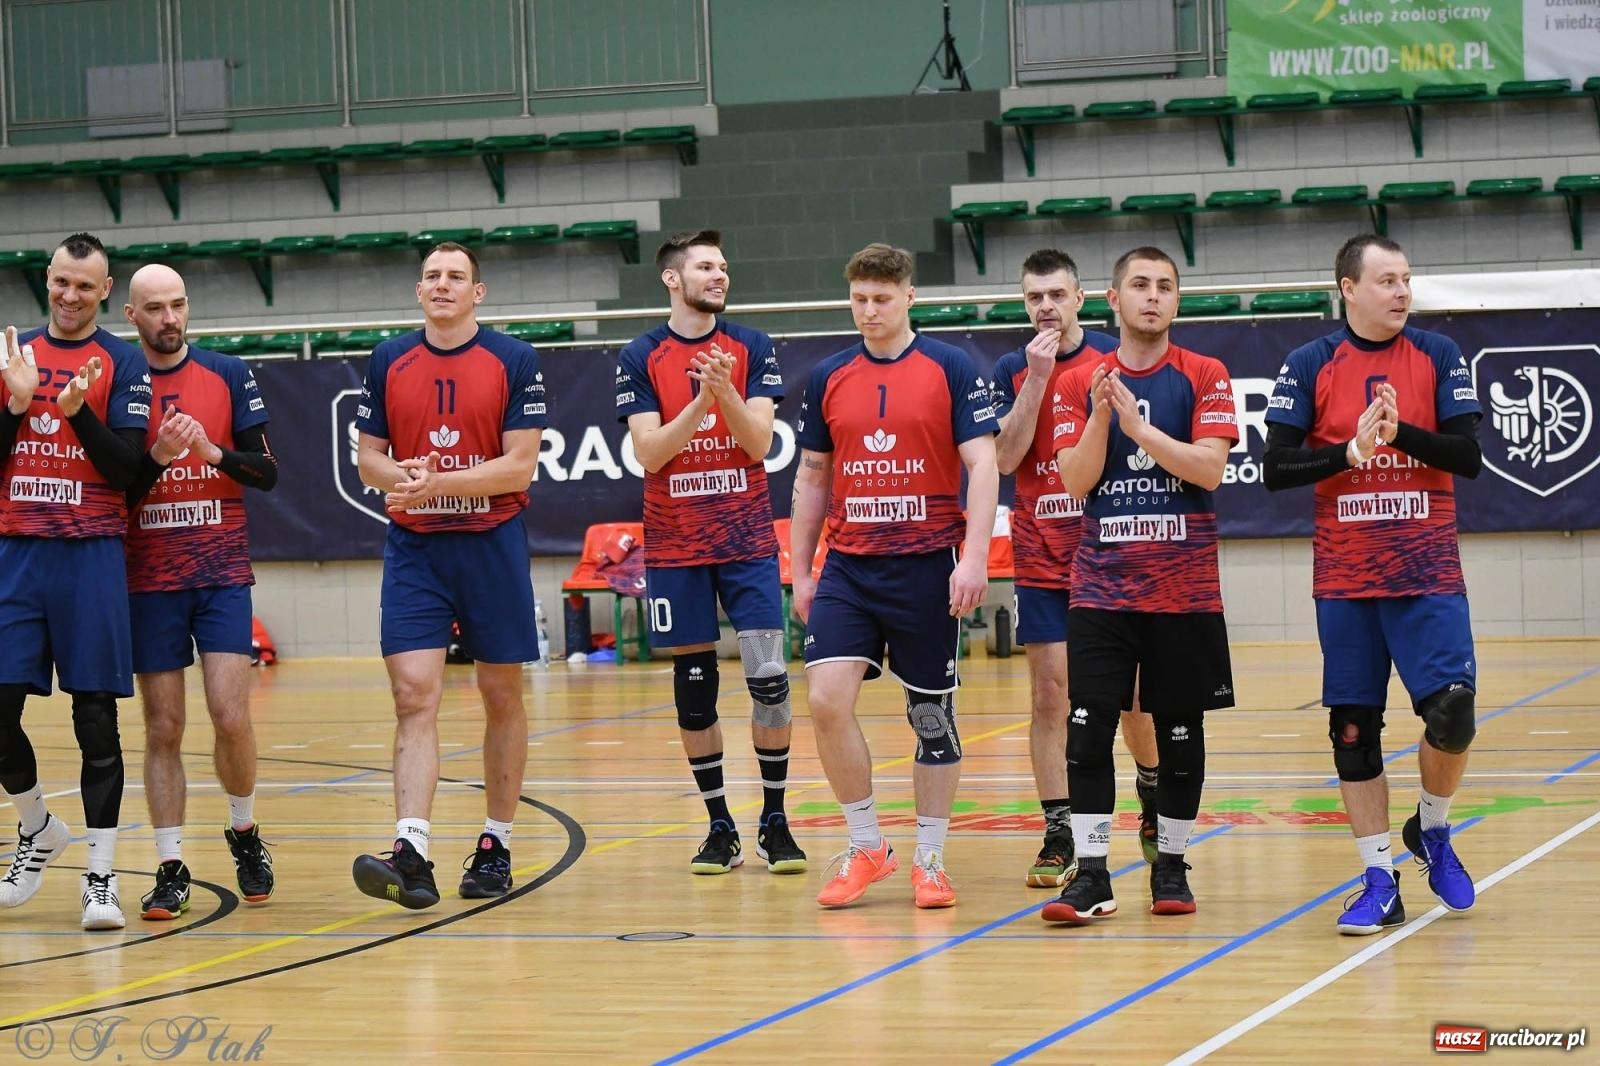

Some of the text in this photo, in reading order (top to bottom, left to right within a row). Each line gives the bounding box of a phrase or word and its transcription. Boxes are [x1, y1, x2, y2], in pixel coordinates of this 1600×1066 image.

[1339, 5, 1491, 26] sklep zoologiczny
[1268, 41, 1496, 78] WWW.ZOO-MAR.PL
[434, 378, 456, 415] 11
[877, 384, 887, 418] 1
[16, 458, 69, 470] GROUP
[682, 452, 730, 465] GROUP
[842, 458, 926, 477] KATOLIK
[672, 469, 744, 494] nowiny.pl
[854, 477, 910, 488] GROUP
[1097, 477, 1184, 496] KATOLIK
[1351, 472, 1412, 484] GROUP
[149, 483, 205, 495] GROUP
[847, 496, 924, 521] nowiny.pl
[1112, 496, 1170, 507] GROUP
[1340, 492, 1425, 520] nowiny.pl
[141, 499, 218, 527] nowiny.pl
[1101, 515, 1183, 541] nowiny.pl
